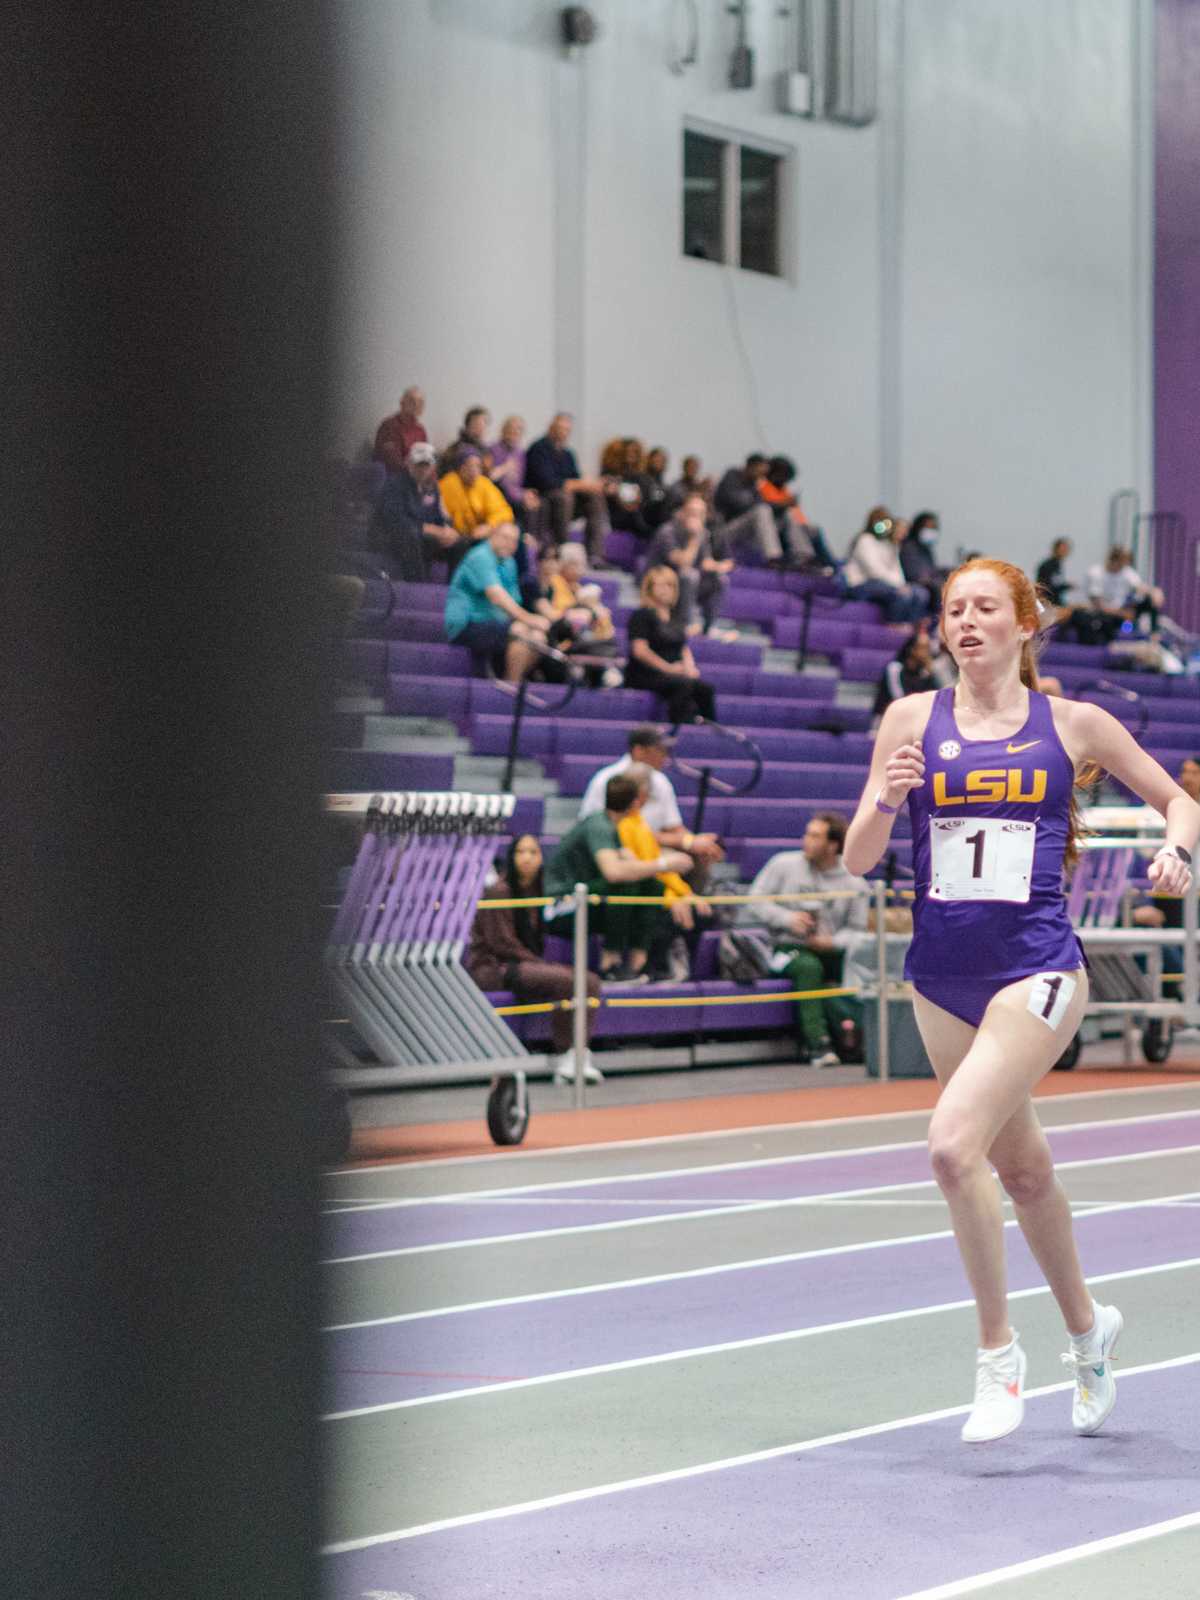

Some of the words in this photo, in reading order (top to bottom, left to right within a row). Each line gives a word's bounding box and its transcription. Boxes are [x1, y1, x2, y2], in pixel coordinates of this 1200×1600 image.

[933, 768, 1047, 807] LSU
[965, 829, 986, 878] 1
[1042, 975, 1063, 1020] 1
